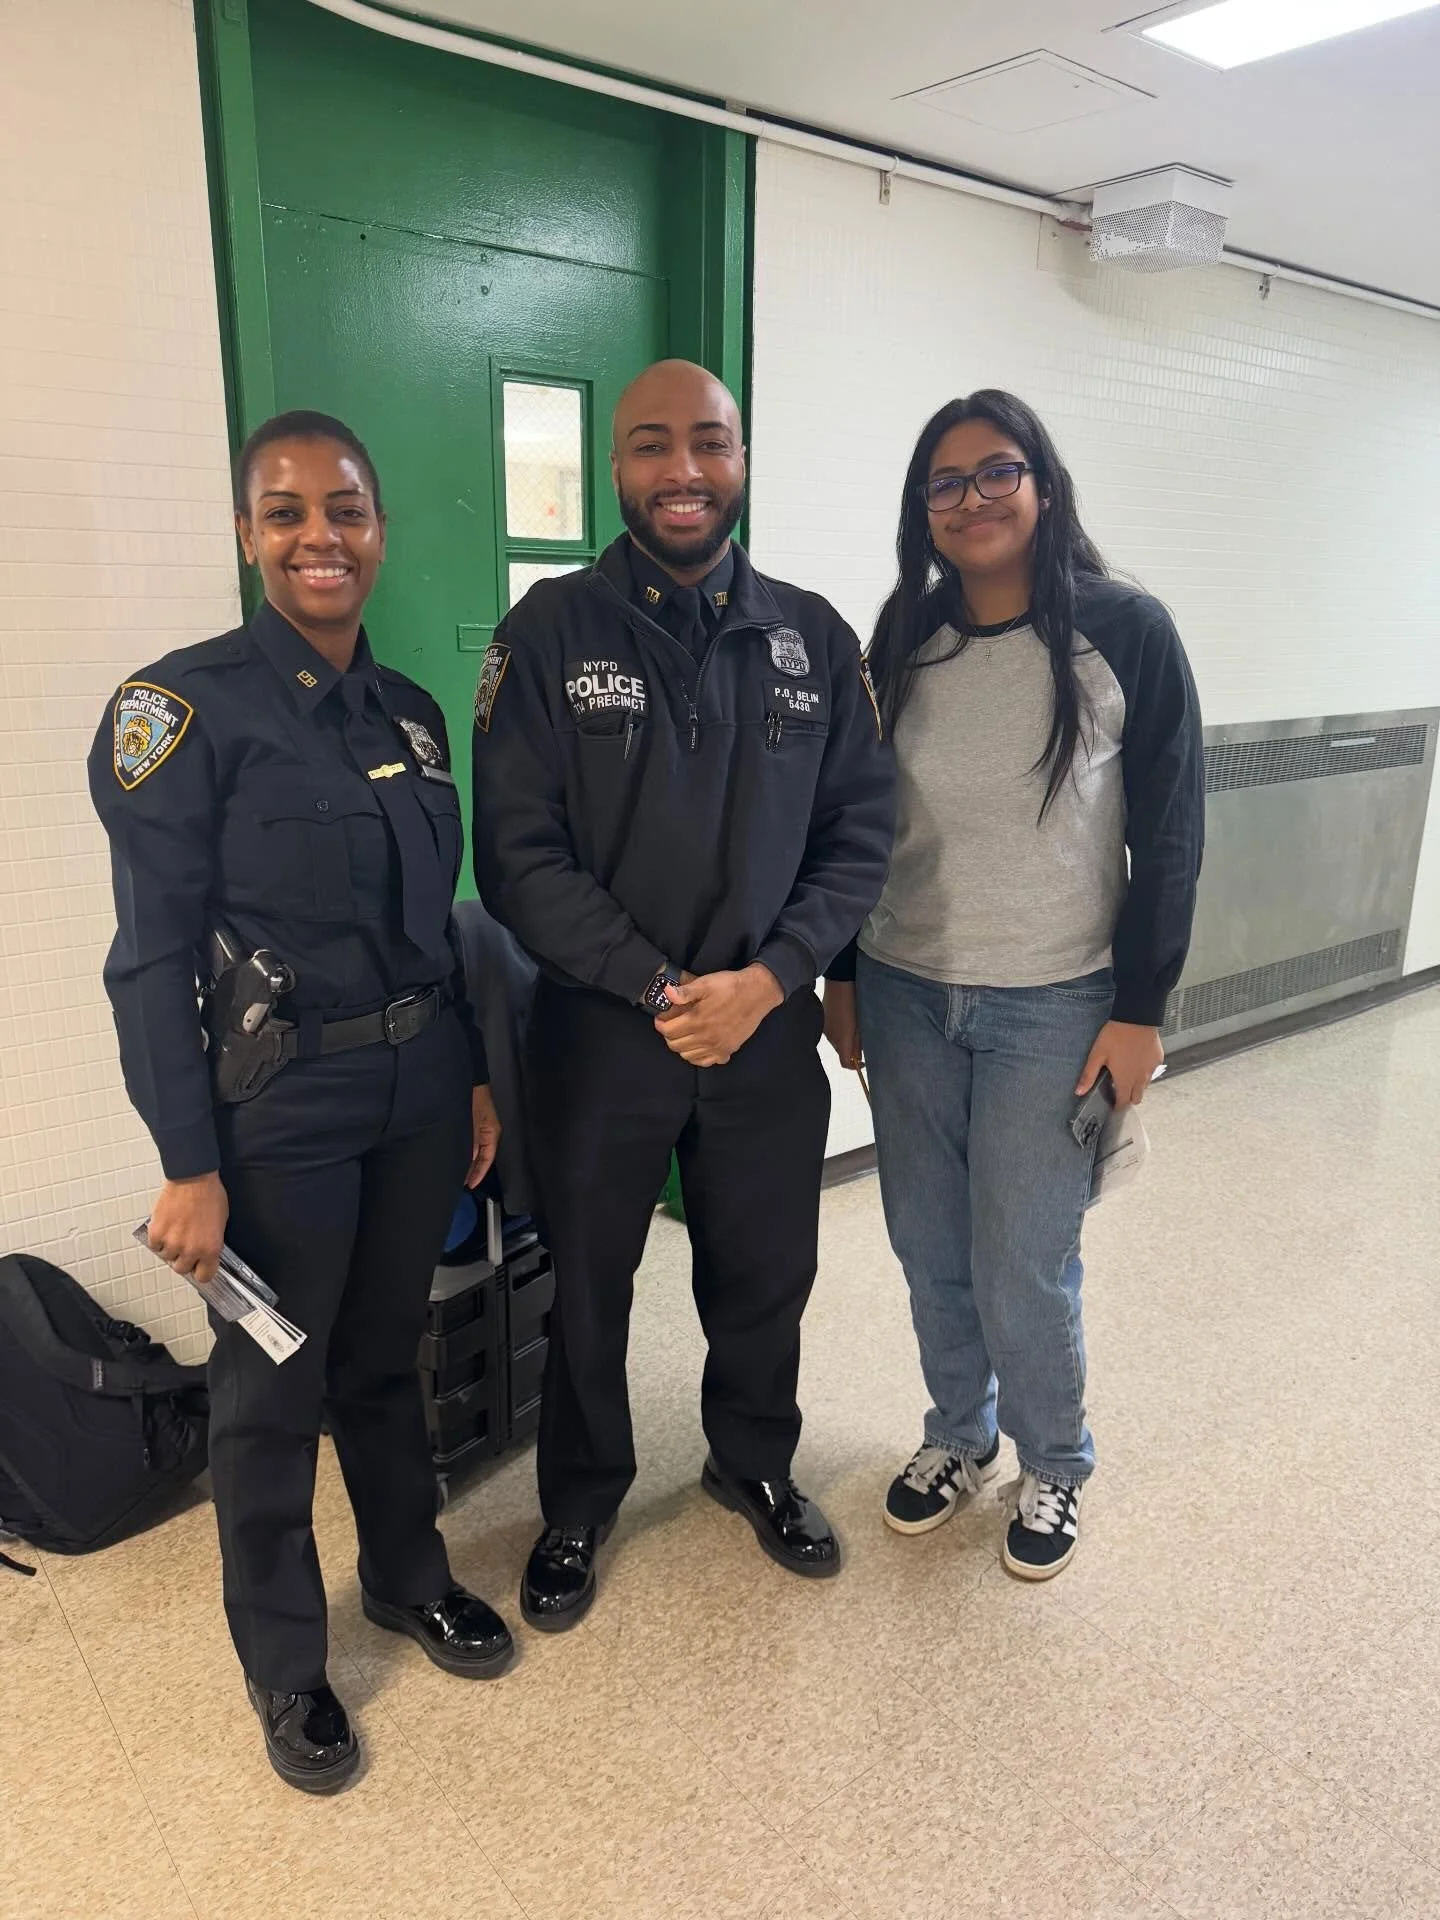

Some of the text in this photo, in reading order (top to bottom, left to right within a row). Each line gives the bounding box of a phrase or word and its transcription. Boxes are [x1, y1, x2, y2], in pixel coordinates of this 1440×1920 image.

[583, 660, 618, 673] NYPD
[780, 658, 806, 671] NYPD
[565, 673, 646, 703] POLICE
[774, 687, 820, 704] P.O. BELIN
[133, 688, 169, 709] POLICE
[588, 694, 646, 712] PRECINCT
[120, 699, 179, 728] DEPARTMENT
[132, 732, 175, 779] NEW YORK
